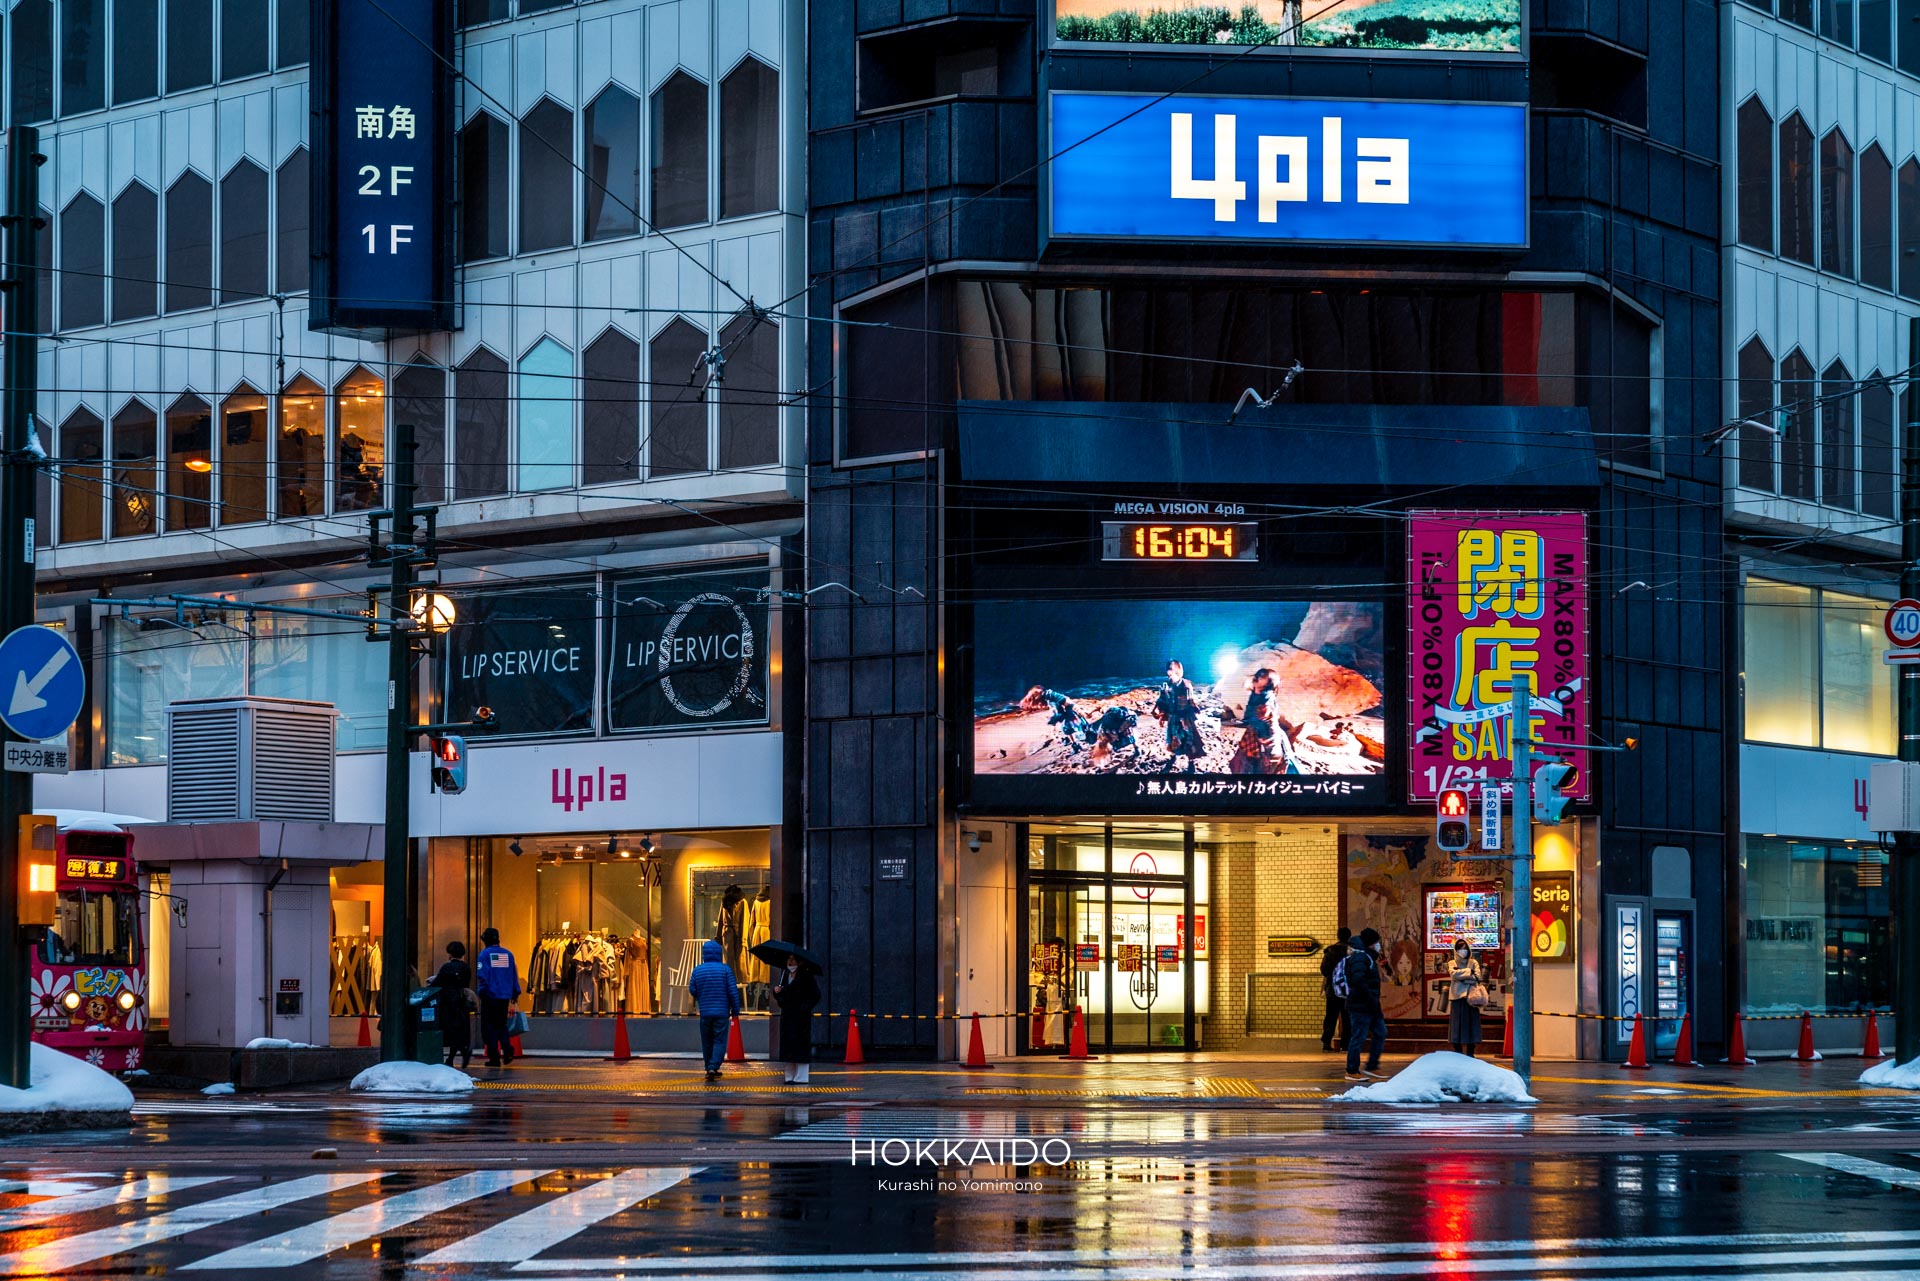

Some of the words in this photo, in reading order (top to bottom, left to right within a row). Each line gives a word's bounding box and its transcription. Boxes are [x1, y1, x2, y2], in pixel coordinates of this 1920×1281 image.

[355, 104, 416, 140] 南角
[358, 165, 415, 196] 2F
[1170, 112, 1409, 223] 4pla
[360, 224, 415, 255] 1F
[1114, 502, 1155, 514] MEGA
[1159, 503, 1209, 515] VISION
[1214, 503, 1245, 517] 4pla
[1135, 527, 1232, 558] 16:04
[1451, 529, 1545, 711] 閉店
[1894, 612, 1919, 635] 40
[462, 653, 488, 679] LIP
[491, 647, 581, 677] SERVICE
[627, 640, 656, 668] LIP
[657, 633, 753, 663] SERVICE
[7, 746, 68, 769] 中央分離帯
[551, 766, 627, 812] 4pla
[1485, 790, 1497, 847] 斜め横断専用
[1533, 885, 1570, 903] Seria
[1560, 904, 1569, 913] 4F
[75, 968, 123, 996] ビッグ
[1622, 916, 1637, 1032] TOBACCO
